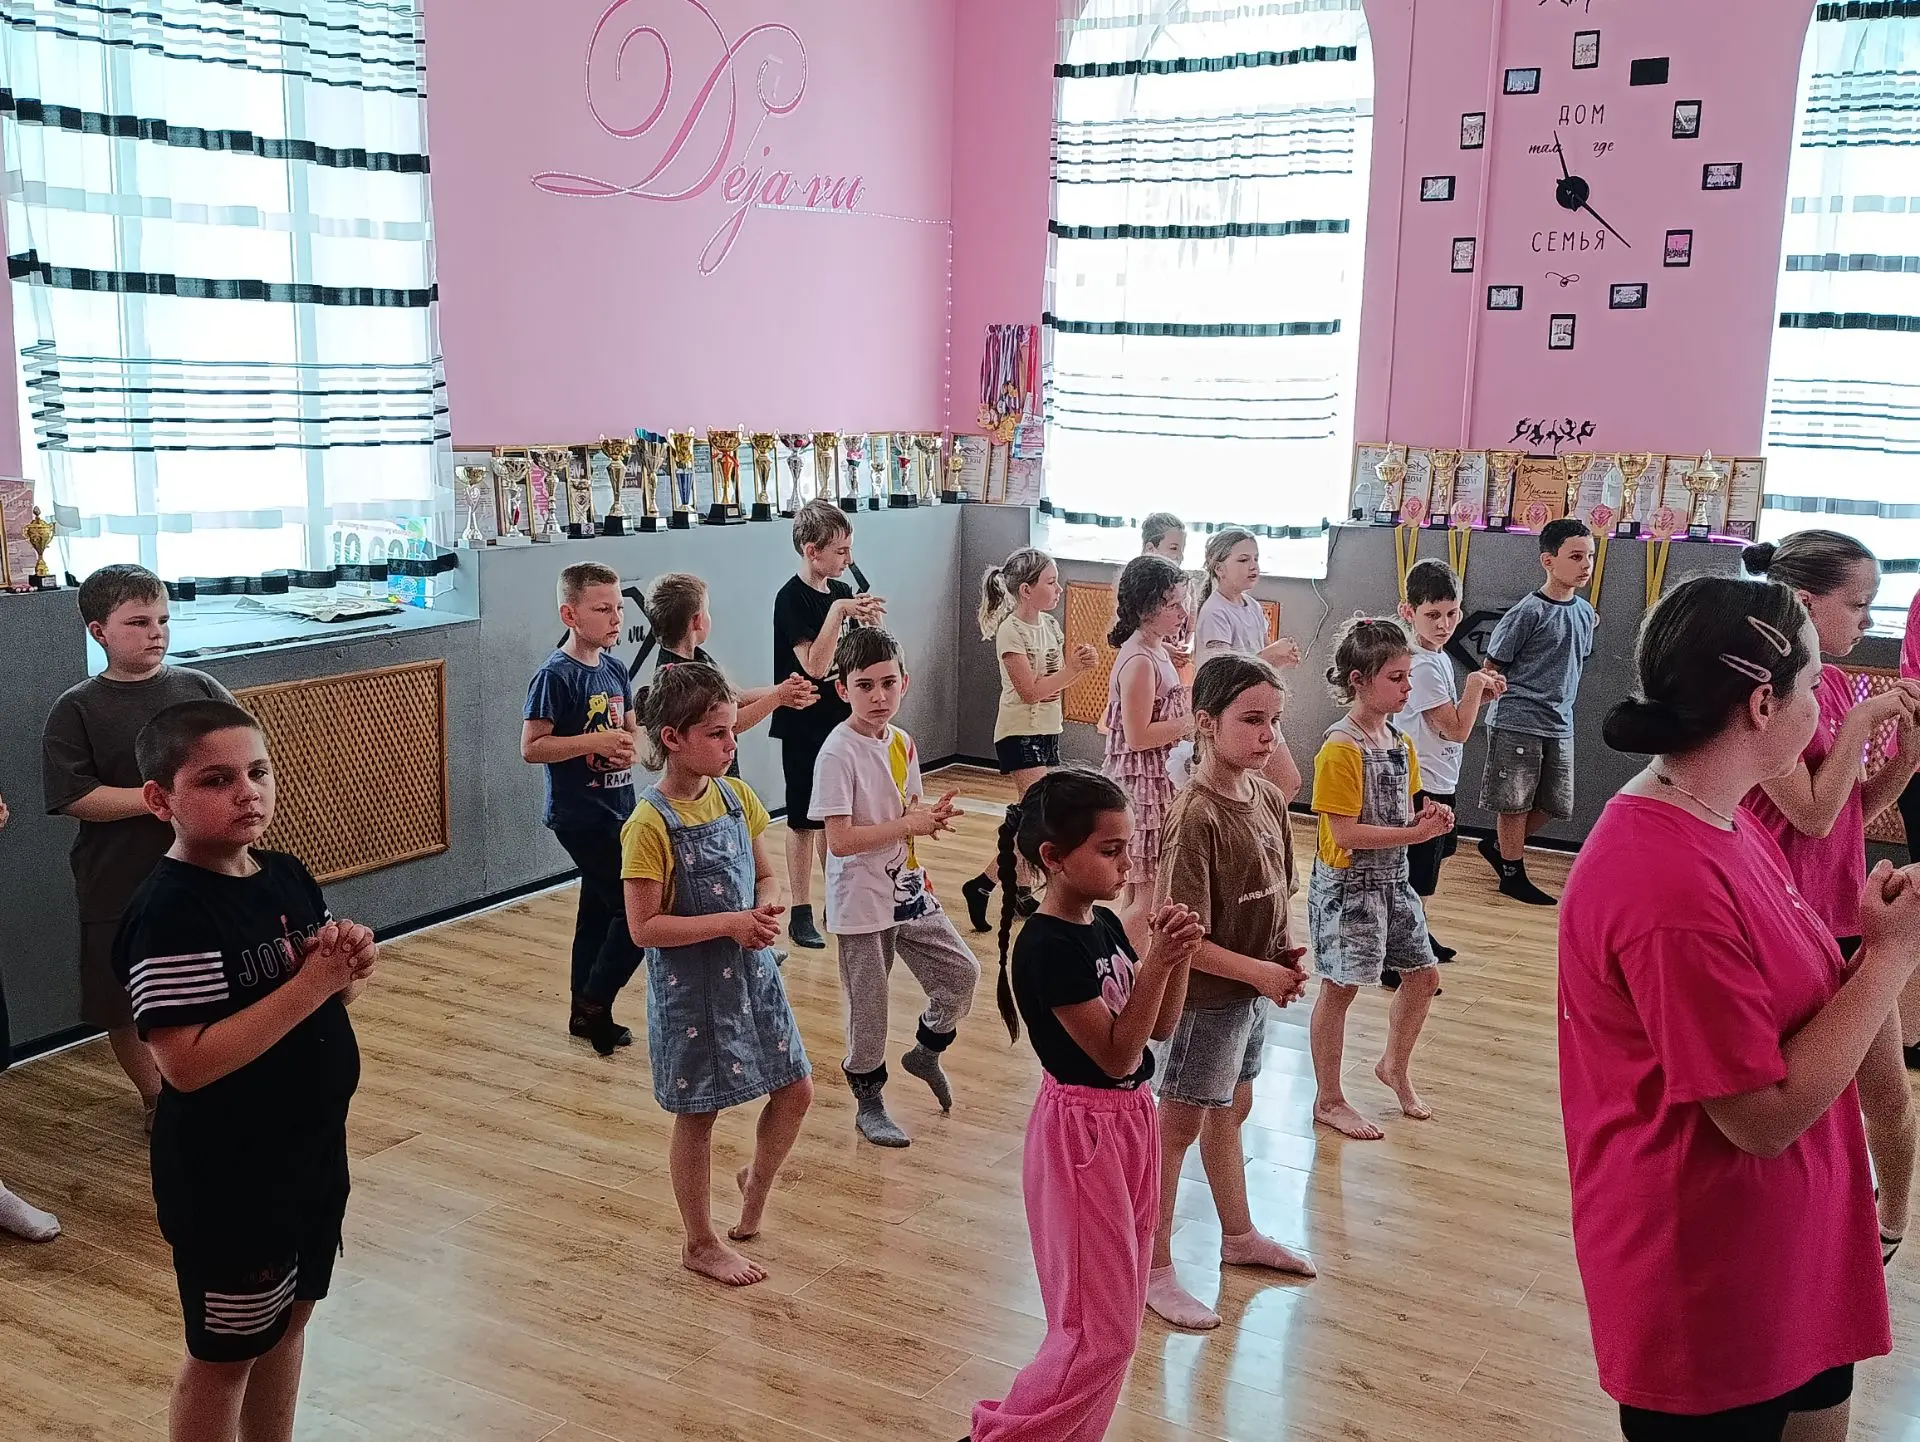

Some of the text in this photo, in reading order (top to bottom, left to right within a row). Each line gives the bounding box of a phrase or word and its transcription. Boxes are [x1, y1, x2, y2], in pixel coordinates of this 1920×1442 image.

[1558, 104, 1605, 126] ДОМ
[1592, 140, 1615, 158] где
[1531, 229, 1606, 253] СЕМЬЯ
[238, 922, 322, 987] JORD
